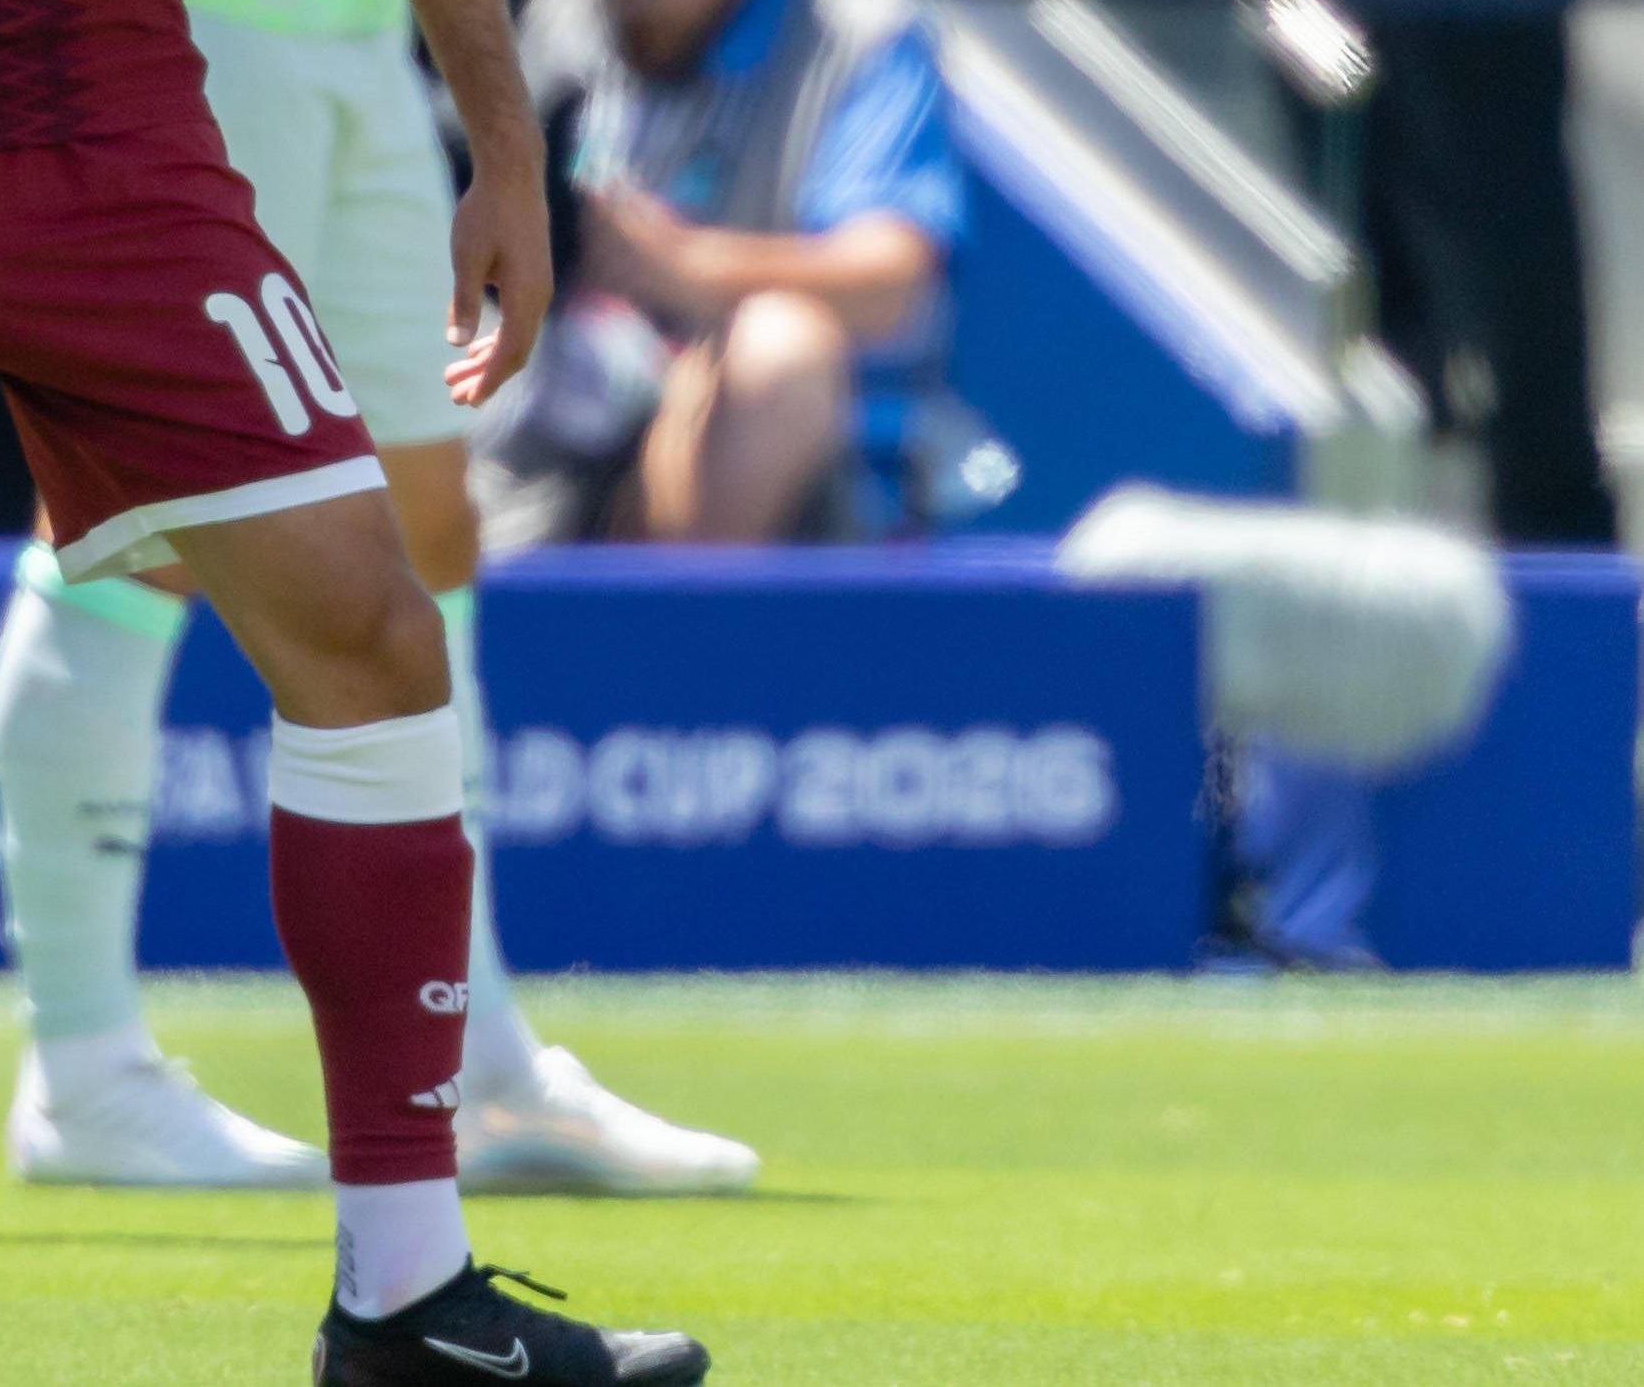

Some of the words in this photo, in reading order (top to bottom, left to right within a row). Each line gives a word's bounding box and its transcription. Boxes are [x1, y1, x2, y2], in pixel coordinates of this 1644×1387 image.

[205, 271, 358, 437] 10
[585, 727, 779, 843] CUP
[781, 725, 1109, 845] 2026
[418, 979, 470, 1015] QF
